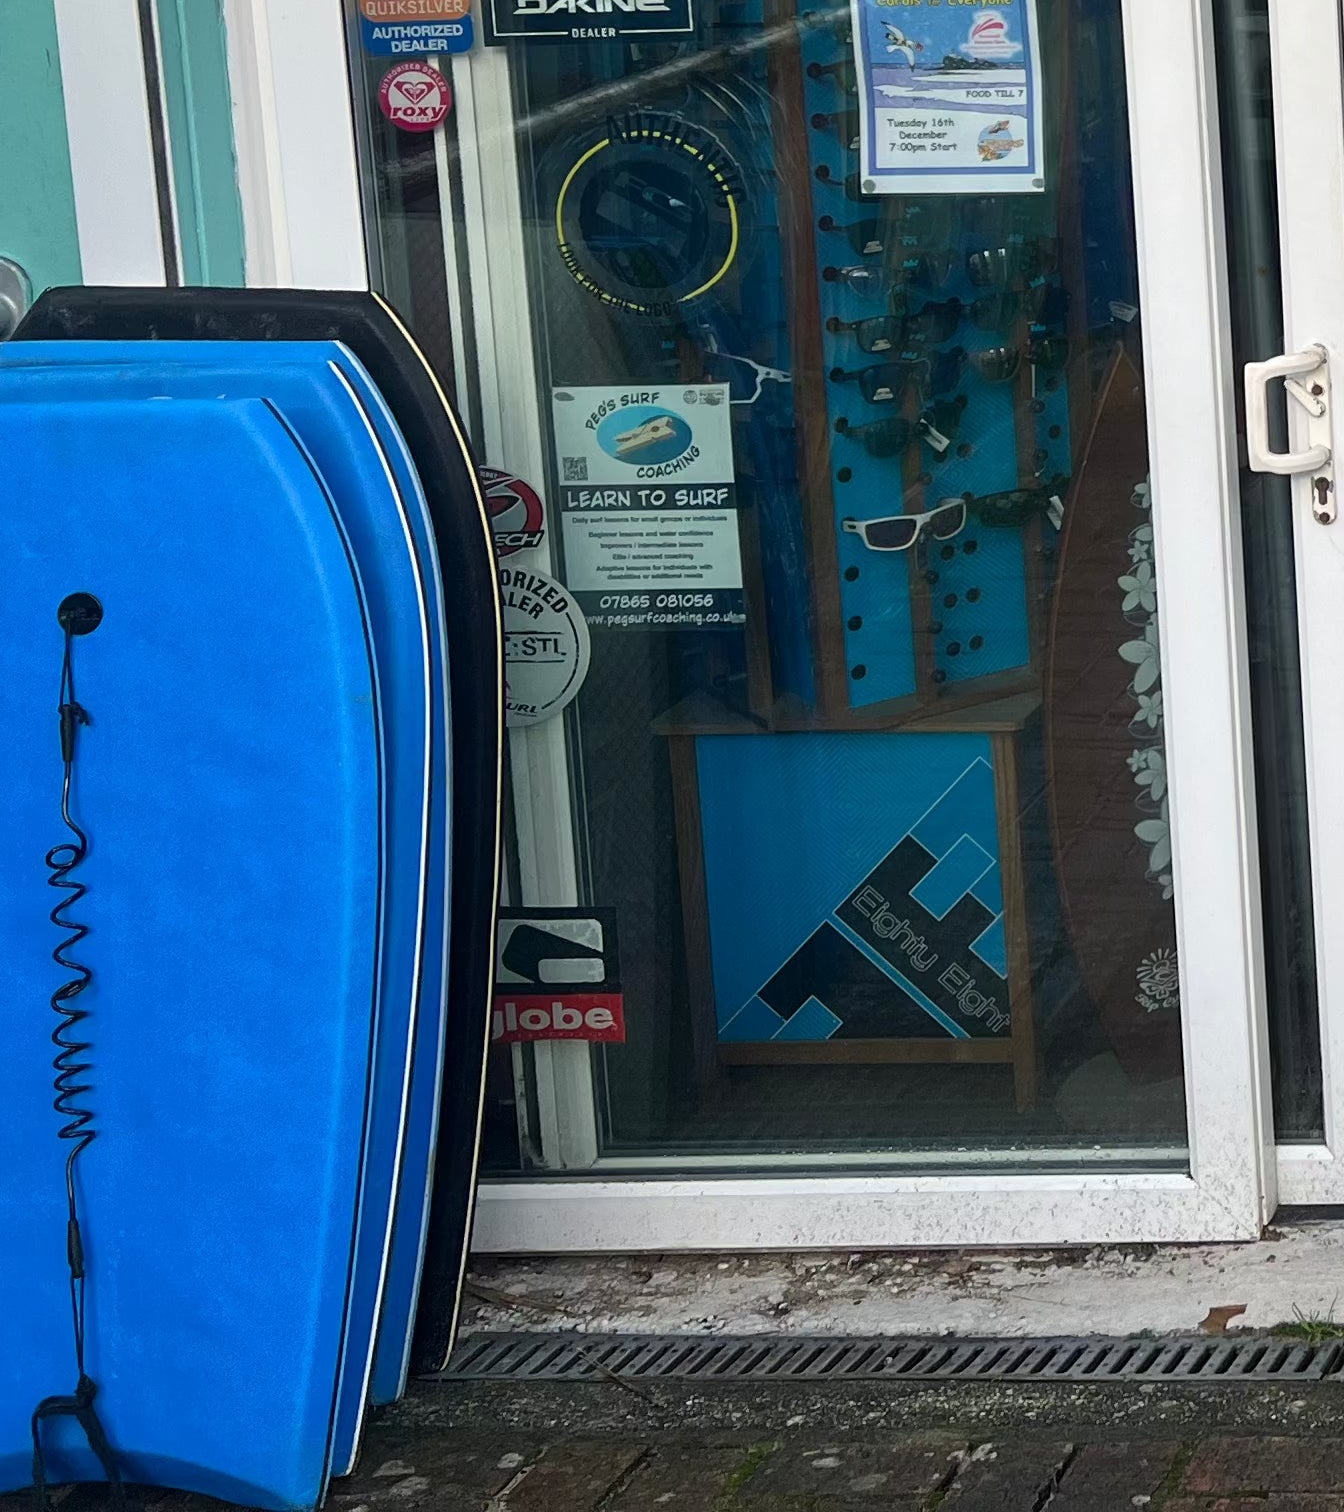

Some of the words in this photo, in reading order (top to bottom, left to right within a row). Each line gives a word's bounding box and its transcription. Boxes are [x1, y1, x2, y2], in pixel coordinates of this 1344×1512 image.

[372, 24, 464, 40] AUTHORIZED
[571, 27, 617, 39] DEALER
[391, 38, 449, 53] DEALER
[380, 63, 421, 94] AUTHORIZED
[422, 65, 447, 93] DEALER
[966, 89, 992, 99] FOOD
[994, 89, 1015, 99] TILL
[1017, 88, 1024, 98] 7
[390, 104, 447, 120] roxy
[887, 118, 928, 130] Tuesday
[931, 117, 955, 128] 16th
[899, 130, 948, 140] December
[889, 142, 927, 154] 7:00pm
[930, 141, 957, 152] Start
[585, 399, 616, 431] PEG'S
[620, 391, 660, 406] SURF
[636, 445, 701, 479] COACHING
[567, 490, 631, 508] LEARN
[637, 489, 666, 506] TO
[674, 488, 729, 507] SURF
[600, 595, 650, 609] 07865
[656, 593, 714, 608] 081056
[851, 884, 939, 973] Eighty
[937, 961, 1011, 1034] Eight
